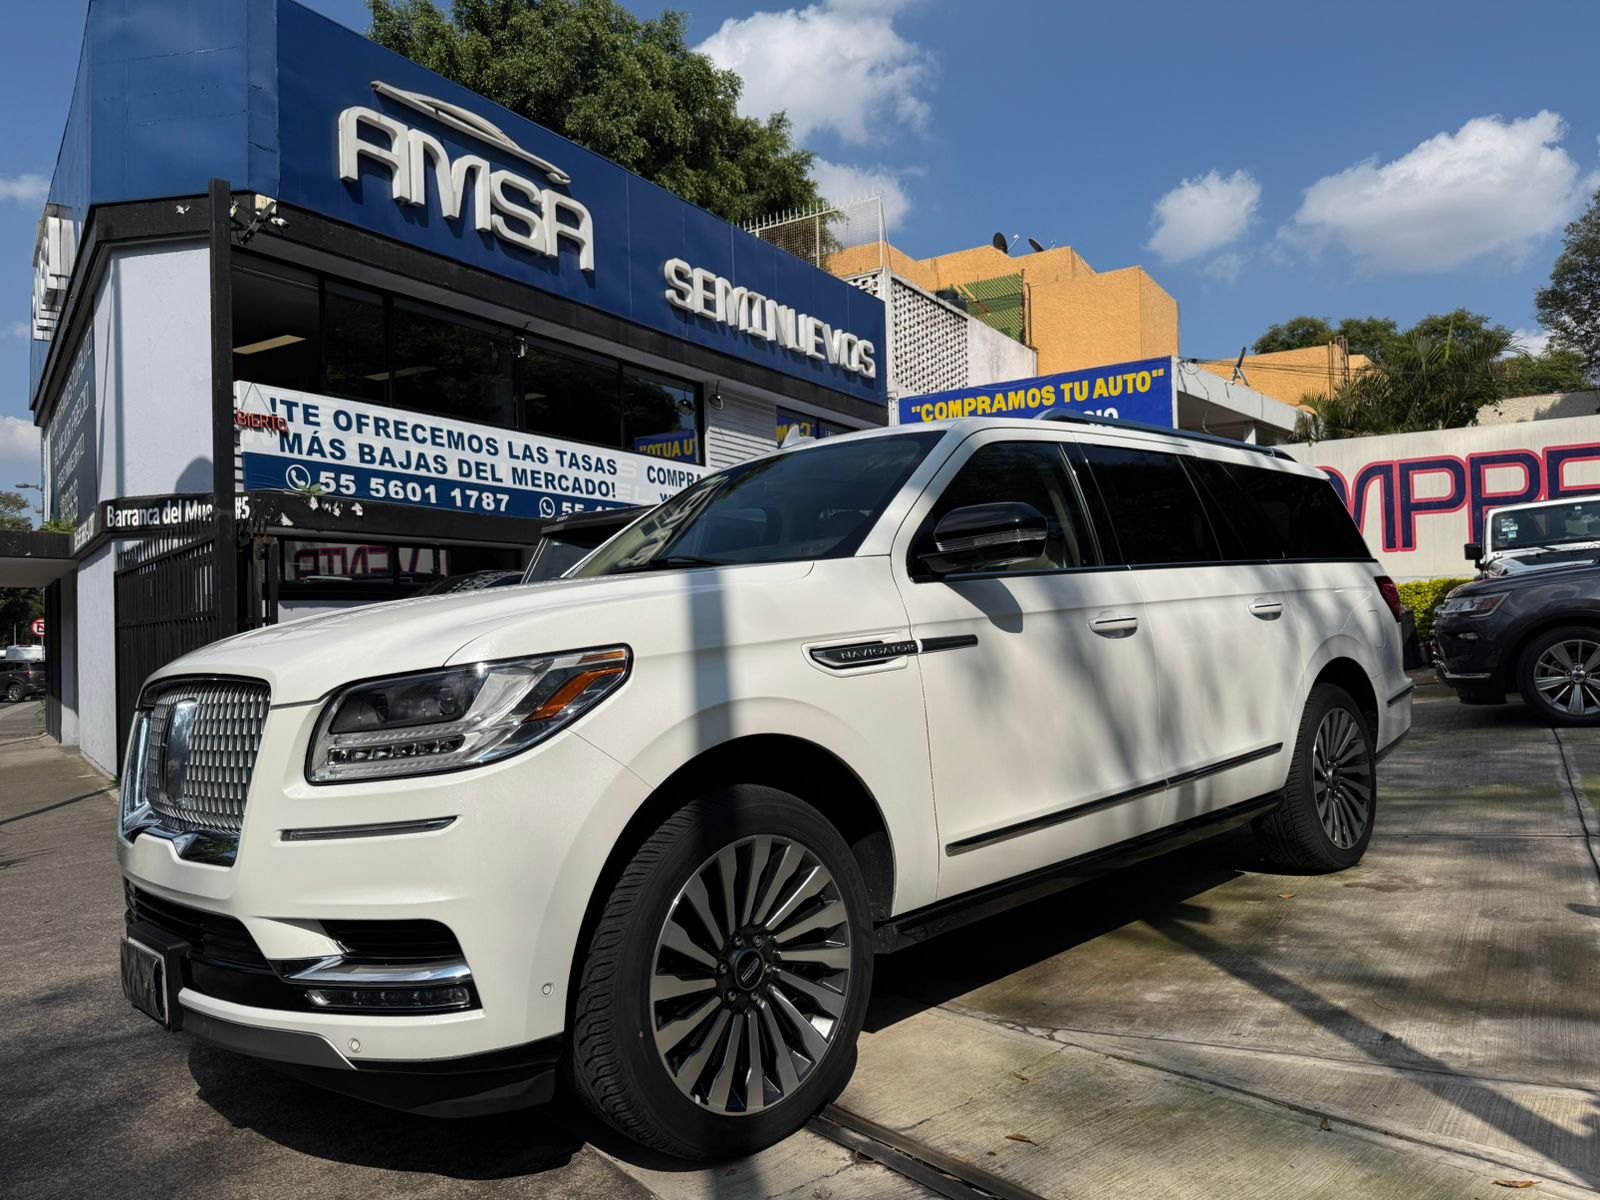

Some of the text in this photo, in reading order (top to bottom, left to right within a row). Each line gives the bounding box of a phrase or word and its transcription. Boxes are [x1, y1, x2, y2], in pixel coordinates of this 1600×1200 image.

[338, 106, 595, 272] AMSA
[664, 257, 877, 379] SEMINUEVOS
[1063, 379, 1089, 403] TU
[279, 430, 347, 461] MÁS
[358, 442, 448, 475] BAJAS
[457, 458, 504, 483] DEL
[511, 466, 617, 499] MERCADO!
[333, 409, 499, 457] OFRECEMOS
[507, 440, 549, 465] LAS
[555, 449, 618, 476] TASAS
[106, 505, 160, 527] Barranca
[162, 499, 182, 525] del
[318, 470, 510, 512] 55 5601 1787
[841, 644, 914, 659] NAVIGATOR
